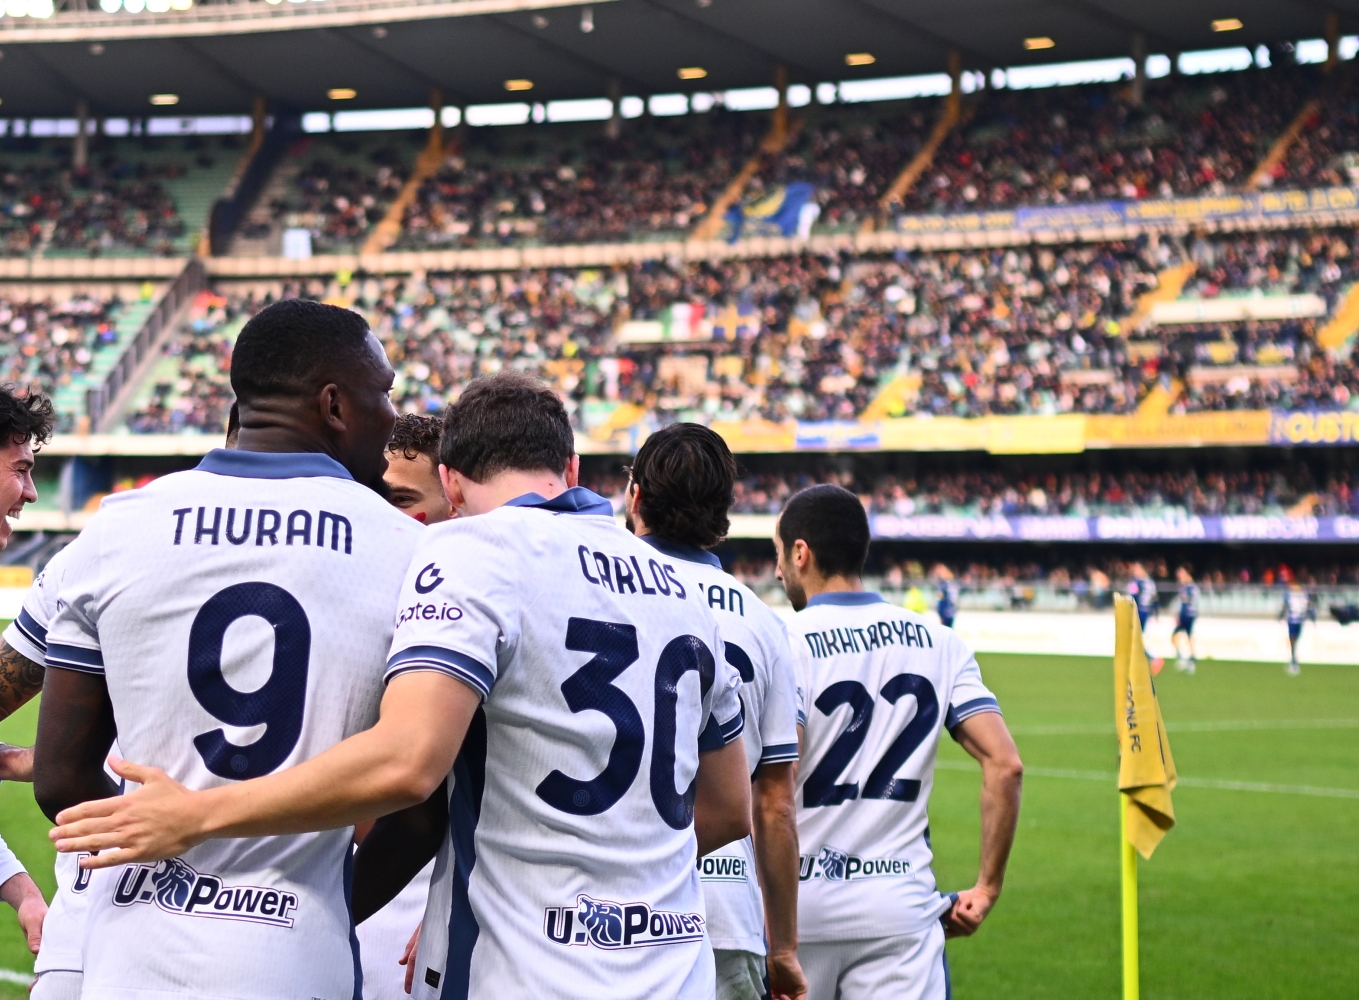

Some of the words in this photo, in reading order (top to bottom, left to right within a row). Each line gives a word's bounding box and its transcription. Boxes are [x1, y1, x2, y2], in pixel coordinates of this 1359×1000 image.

[173, 506, 353, 555] THURAM
[578, 544, 686, 600] CARLOS
[187, 581, 311, 781] 9
[805, 620, 933, 658] MKHITARYAN
[536, 617, 715, 831] 30
[802, 673, 940, 809] 22
